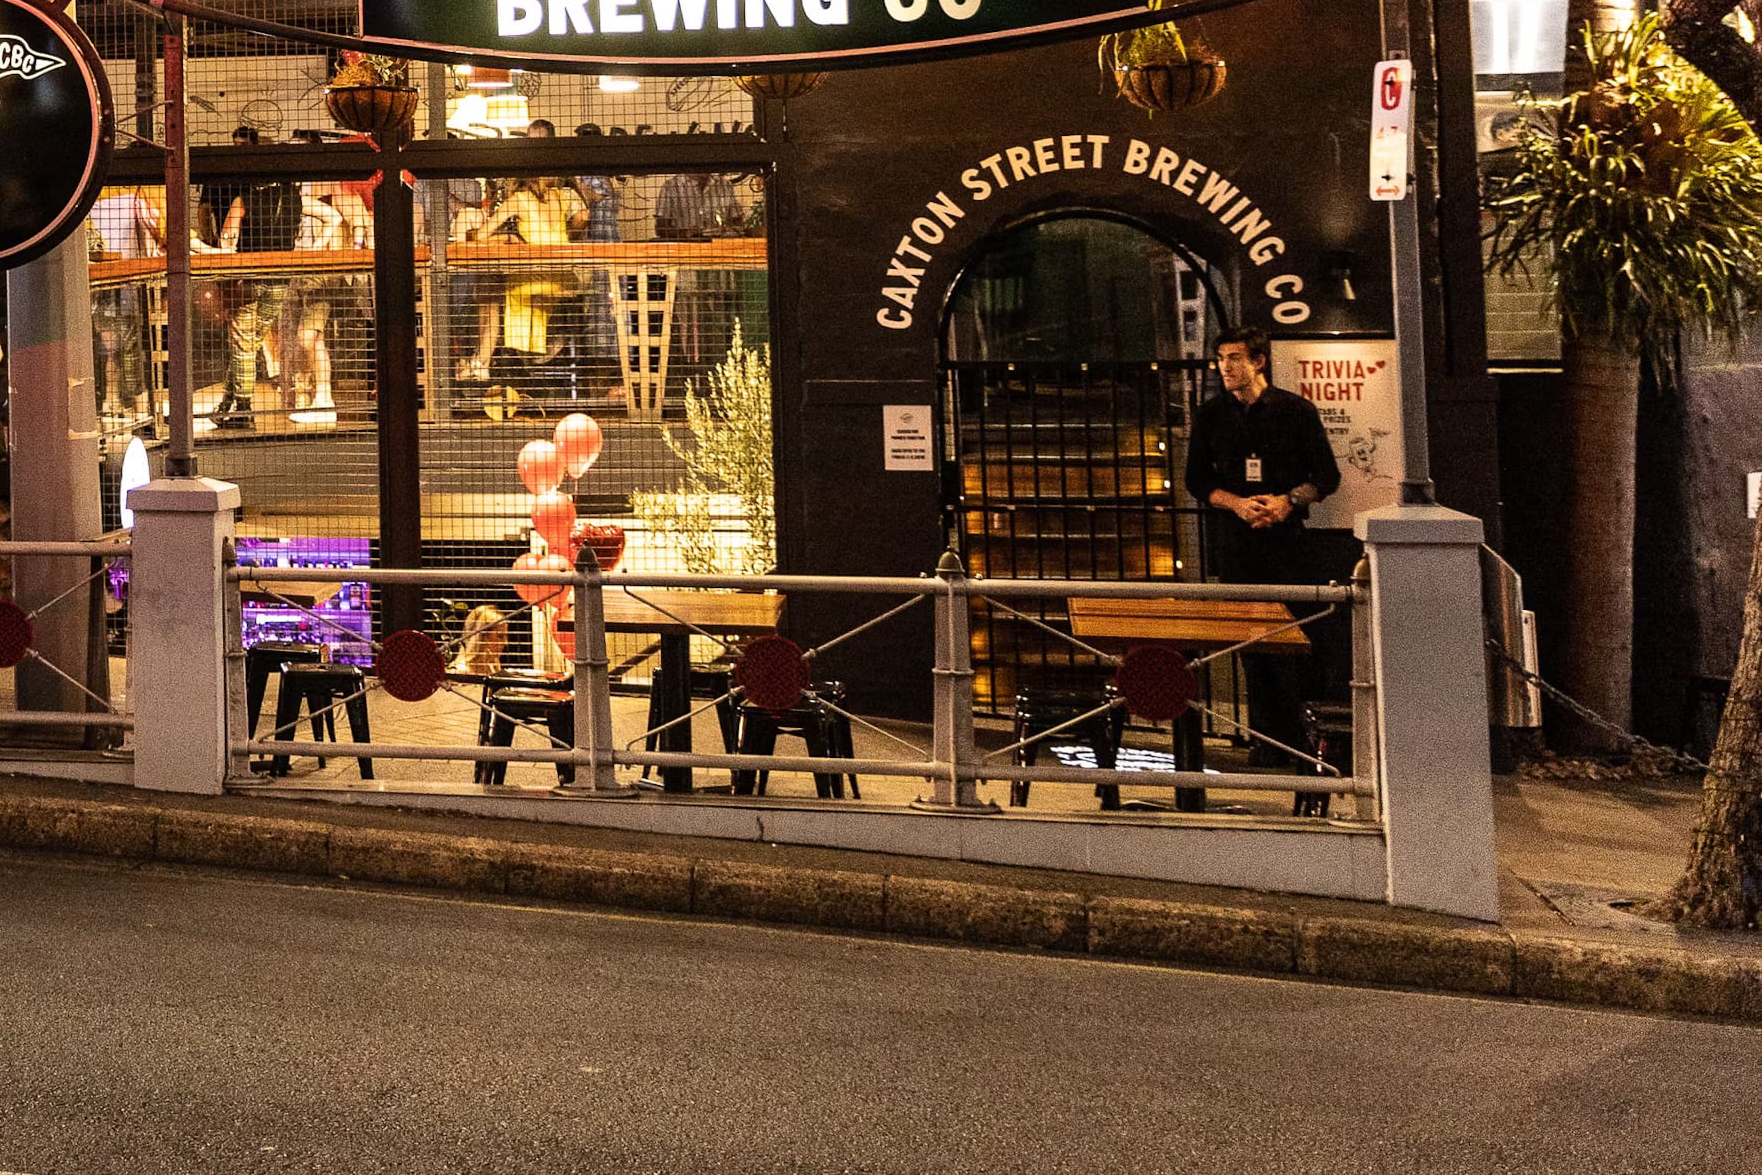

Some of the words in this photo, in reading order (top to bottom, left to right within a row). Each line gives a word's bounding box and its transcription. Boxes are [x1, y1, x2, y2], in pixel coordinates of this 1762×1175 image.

[876, 191, 965, 329] CAXTON
[961, 134, 1110, 201] STREET
[1122, 139, 1285, 266] BREWING
[1265, 273, 1311, 324] CO
[1298, 360, 1365, 379] TRIVIA
[1300, 382, 1364, 401] NIGHT
